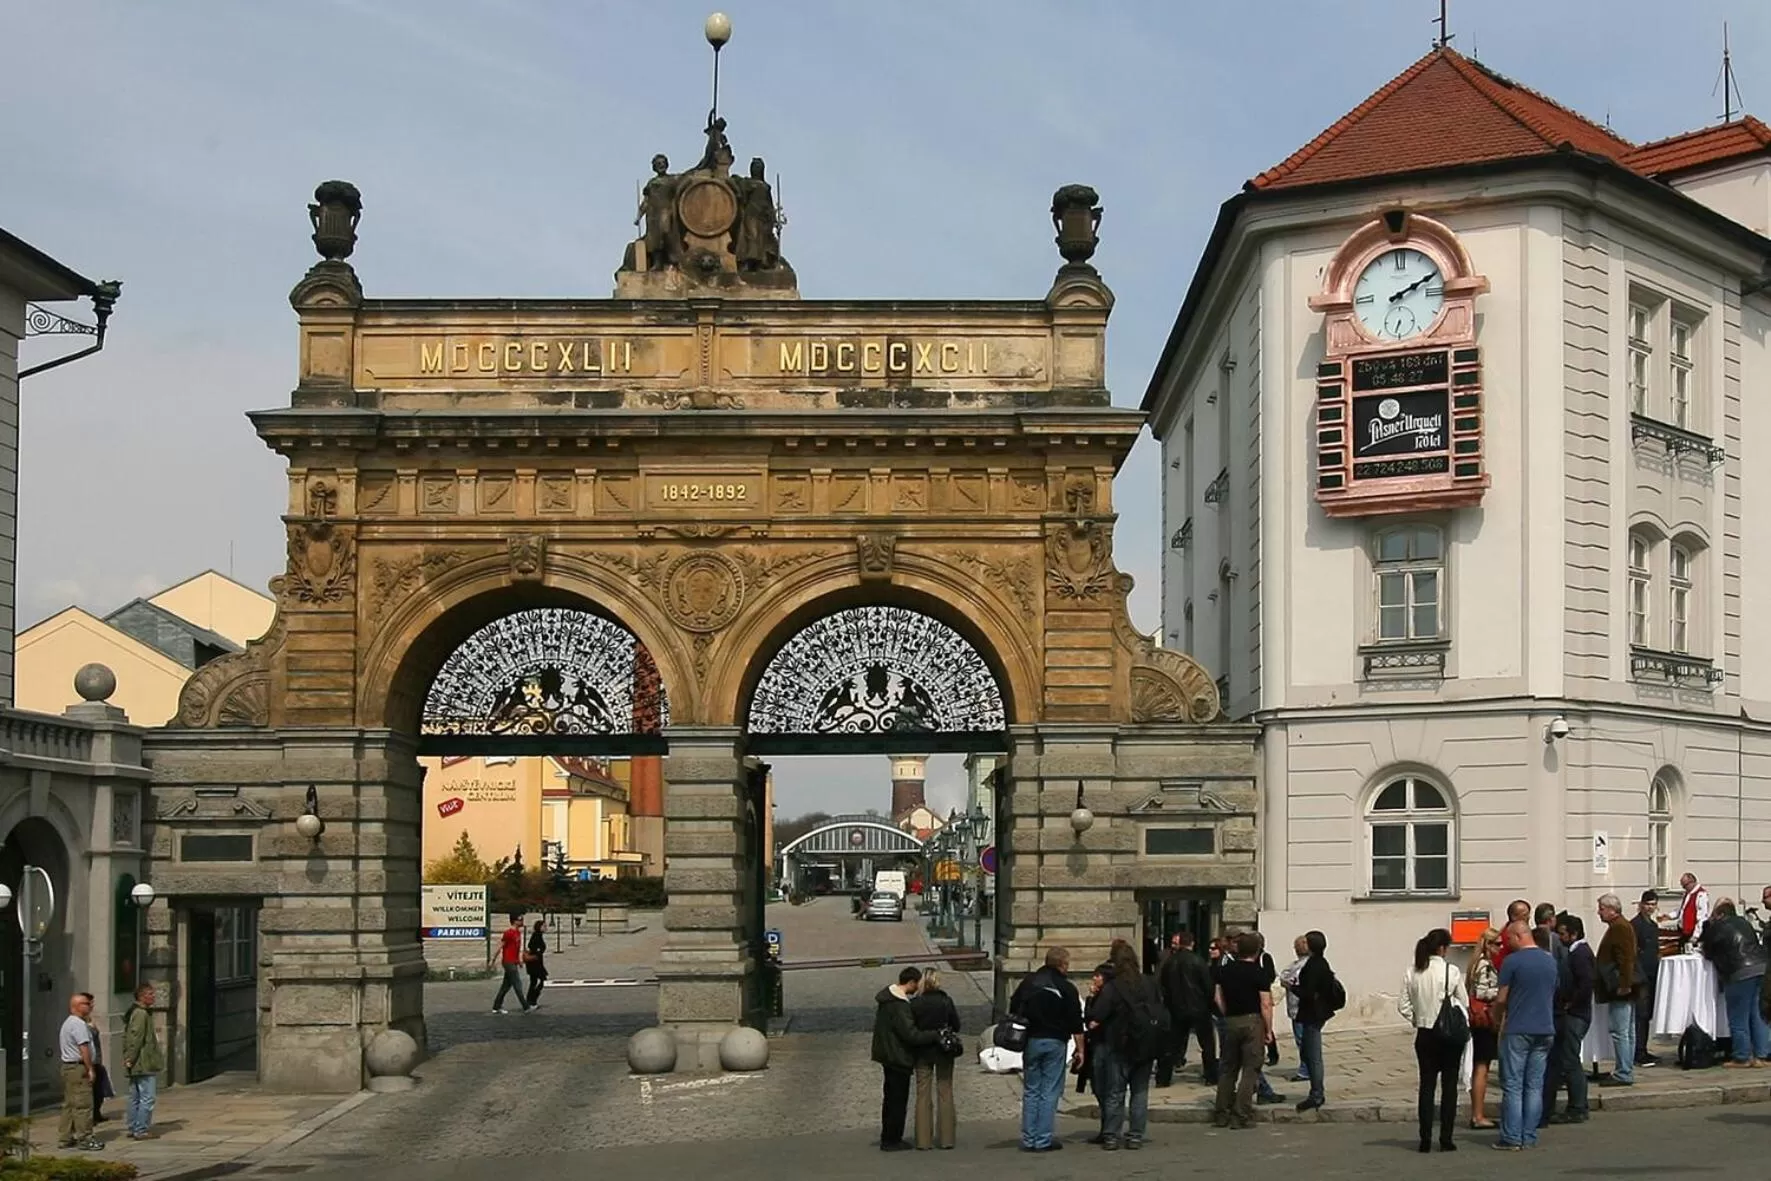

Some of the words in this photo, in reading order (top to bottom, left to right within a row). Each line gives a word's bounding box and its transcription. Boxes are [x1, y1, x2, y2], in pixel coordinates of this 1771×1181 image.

[421, 342, 631, 373] MDCCCXLII
[780, 342, 988, 373] MDCCCXCII
[1368, 417, 1405, 445] Pilsner
[1402, 412, 1442, 434] Urquell
[662, 484, 746, 501] 1842-1892
[447, 890, 484, 900] VÍTEJTE
[437, 928, 481, 937] PARKING
